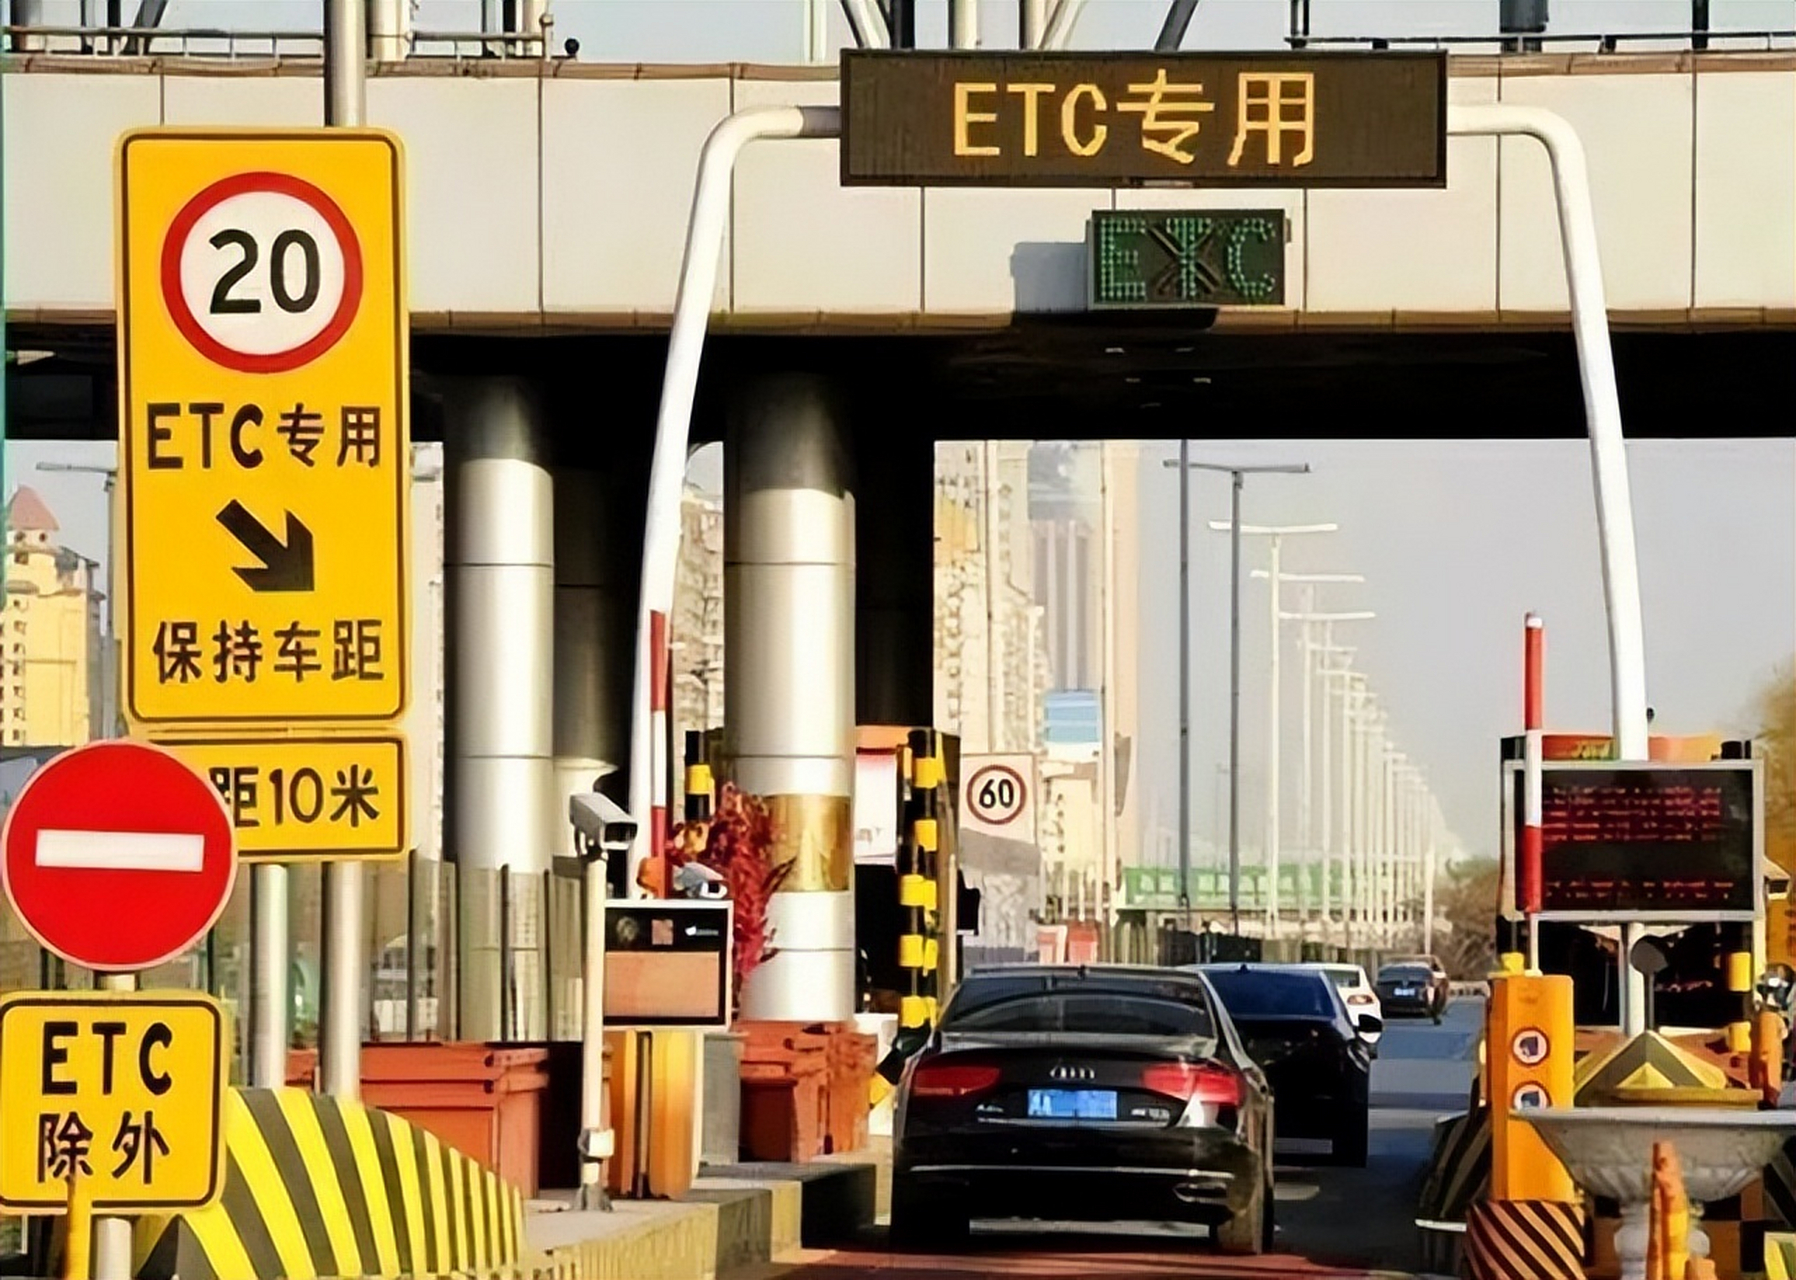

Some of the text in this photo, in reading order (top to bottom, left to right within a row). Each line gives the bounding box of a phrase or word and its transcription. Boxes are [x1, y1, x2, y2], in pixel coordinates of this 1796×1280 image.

[954, 68, 1315, 167] ETC专用
[209, 229, 321, 315] 20
[146, 402, 382, 470] ETC专用
[152, 619, 385, 685] 保持车距
[979, 777, 1015, 810] 60
[42, 1021, 173, 1096] ETC
[37, 1110, 170, 1185] 除外
